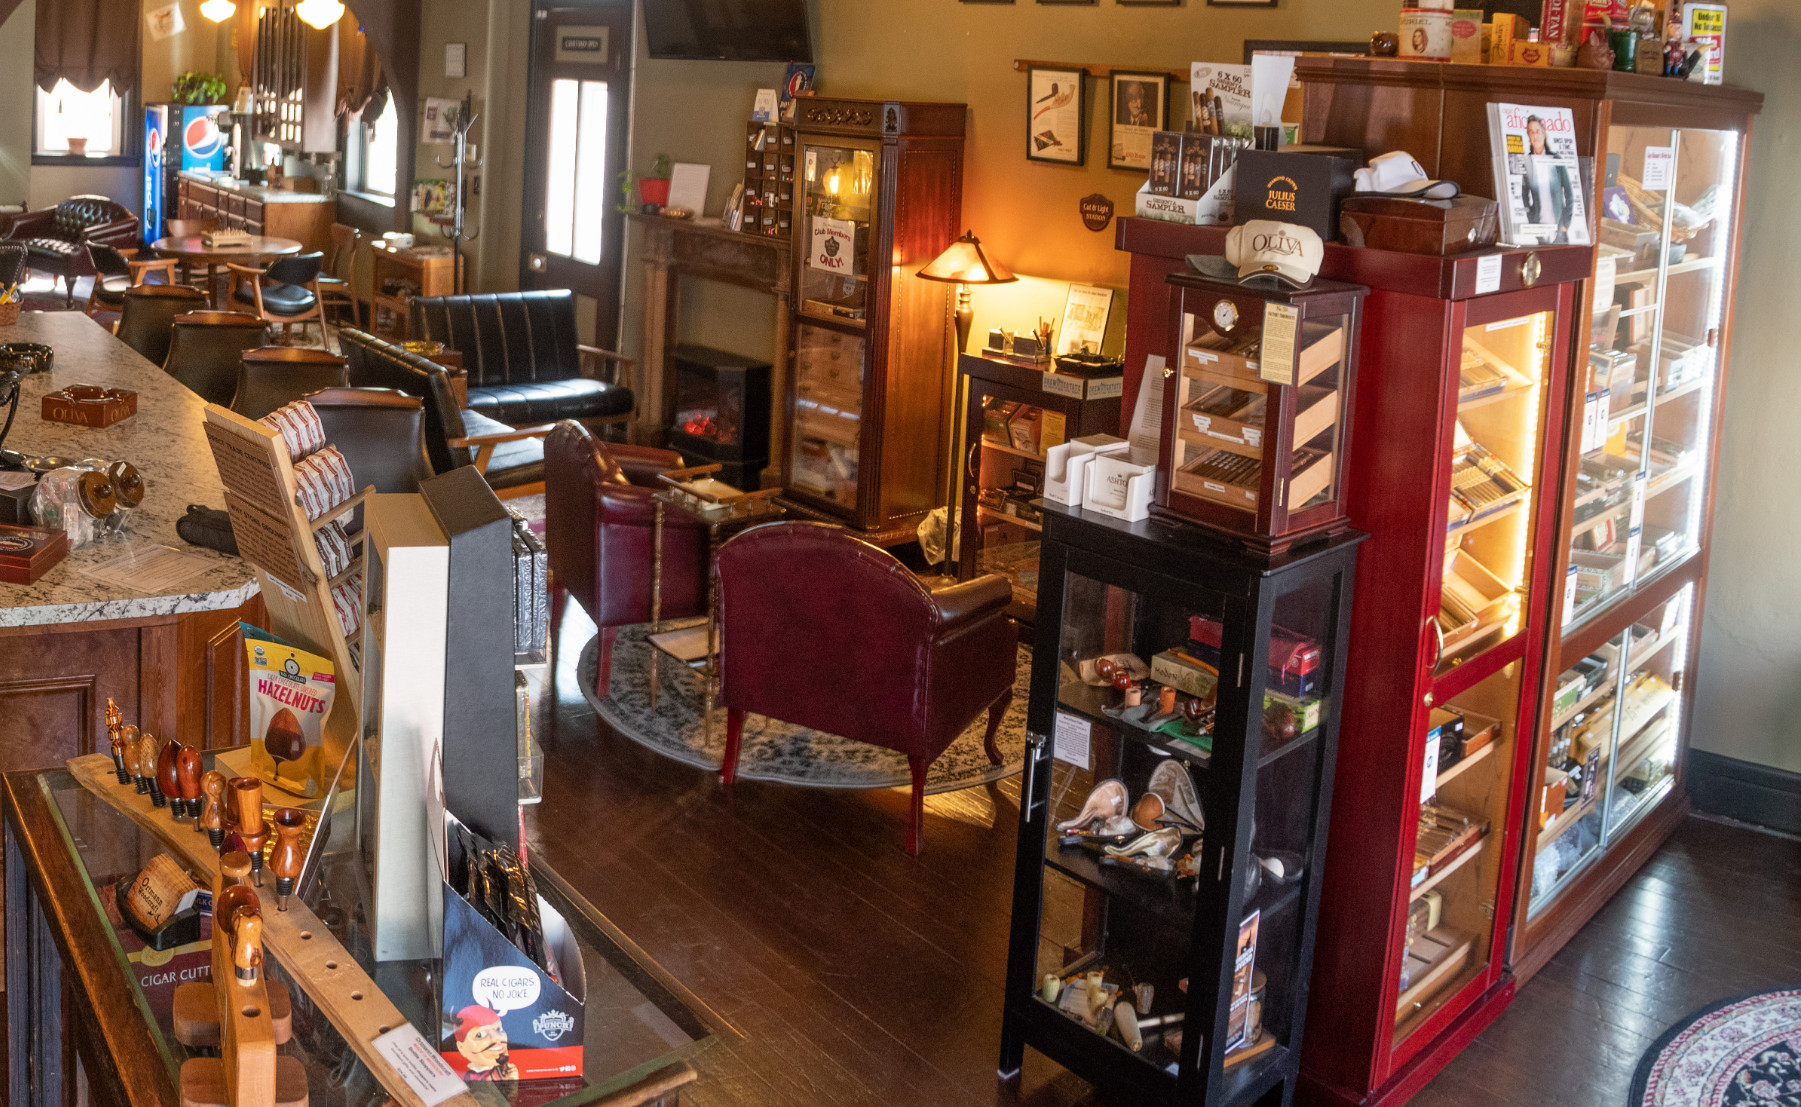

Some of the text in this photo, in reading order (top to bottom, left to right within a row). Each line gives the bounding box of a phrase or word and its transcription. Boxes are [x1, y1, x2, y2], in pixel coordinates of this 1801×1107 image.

[1698, 12, 1714, 21] Under
[1217, 70, 1243, 84] 6 X 60
[1209, 79, 1251, 98] SAMPLER
[1506, 107, 1572, 132] aficado
[1268, 190, 1296, 201] JULIUS
[1083, 203, 1109, 214] Cut & Light
[1146, 200, 1185, 214] SAMPLER
[1265, 200, 1296, 211] CAESER
[1086, 213, 1106, 221] STATION
[814, 227, 851, 242] Club Members
[1252, 230, 1304, 257] OLIVA
[820, 254, 844, 268] ONLY!
[53, 406, 88, 423] OLIVA
[111, 405, 132, 422] OLIVA
[225, 442, 243, 456] TRADE
[243, 452, 272, 470] CERTIFIED
[1106, 476, 1128, 487] ASHTO
[277, 675, 300, 690] CHOCOLATE
[258, 679, 326, 714] HAZELNUTS
[137, 886, 159, 913] Woodcraft
[141, 877, 163, 907] Ortmann
[141, 965, 212, 987] CIGAR CUTT
[480, 978, 499, 988] REAL
[492, 989, 528, 999] NO JOKE
[419, 1058, 436, 1078] Stoppers
[431, 1054, 451, 1077] Woodcraft
